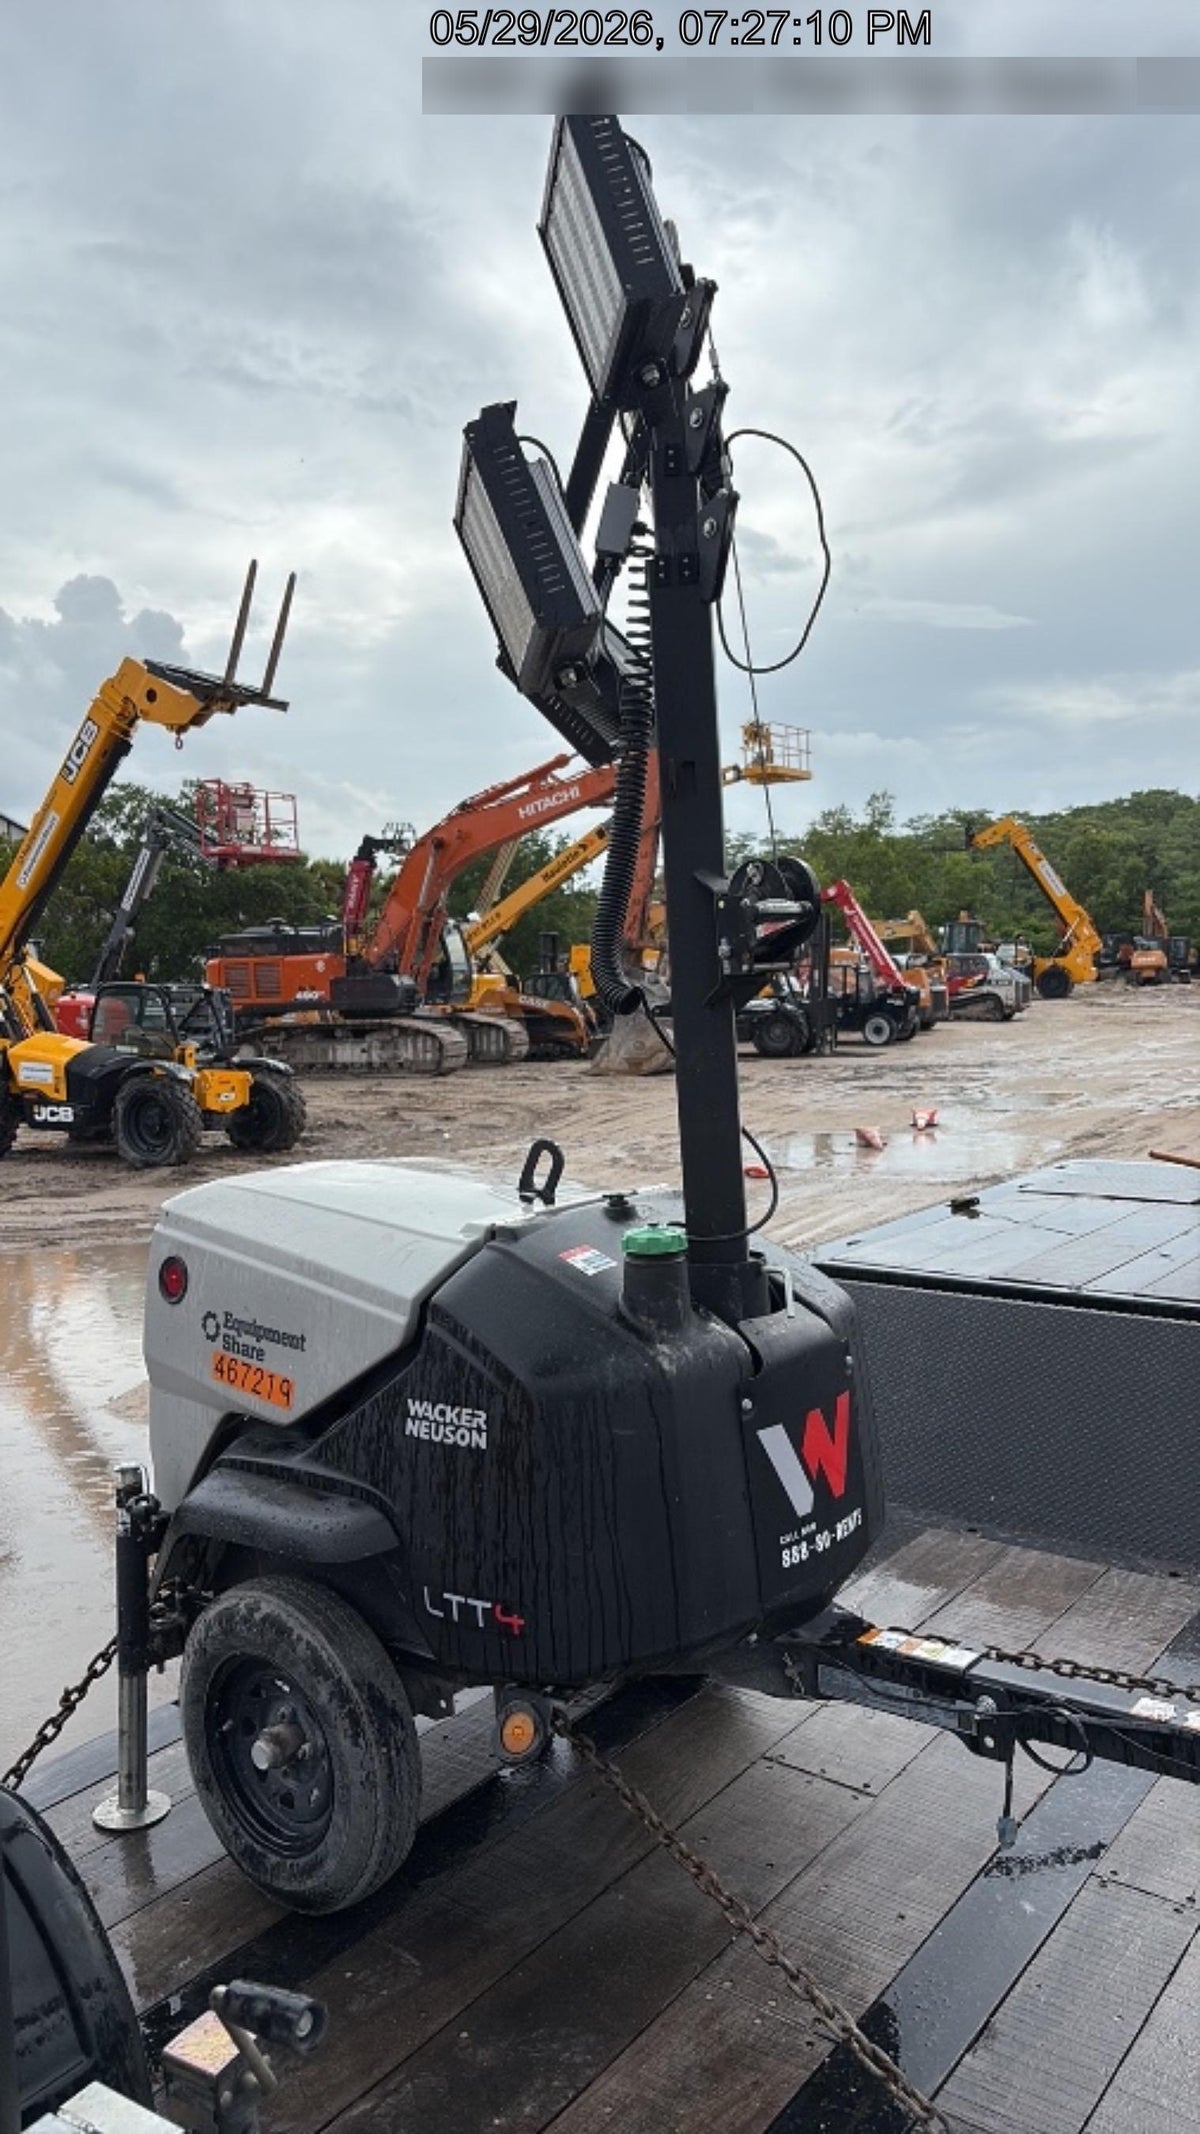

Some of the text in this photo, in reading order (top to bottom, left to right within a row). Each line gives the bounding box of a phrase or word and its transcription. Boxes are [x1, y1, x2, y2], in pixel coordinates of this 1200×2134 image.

[61, 720, 99, 785] JCB
[517, 786, 581, 819] HITACHI
[32, 1104, 75, 1122] JCB
[222, 1310, 307, 1352] Equipment
[222, 1333, 266, 1362] Share
[213, 1354, 291, 1407] 467219
[406, 1397, 488, 1431] WACKER
[404, 1417, 488, 1450] NEUSON
[423, 1585, 526, 1636] LTT4
